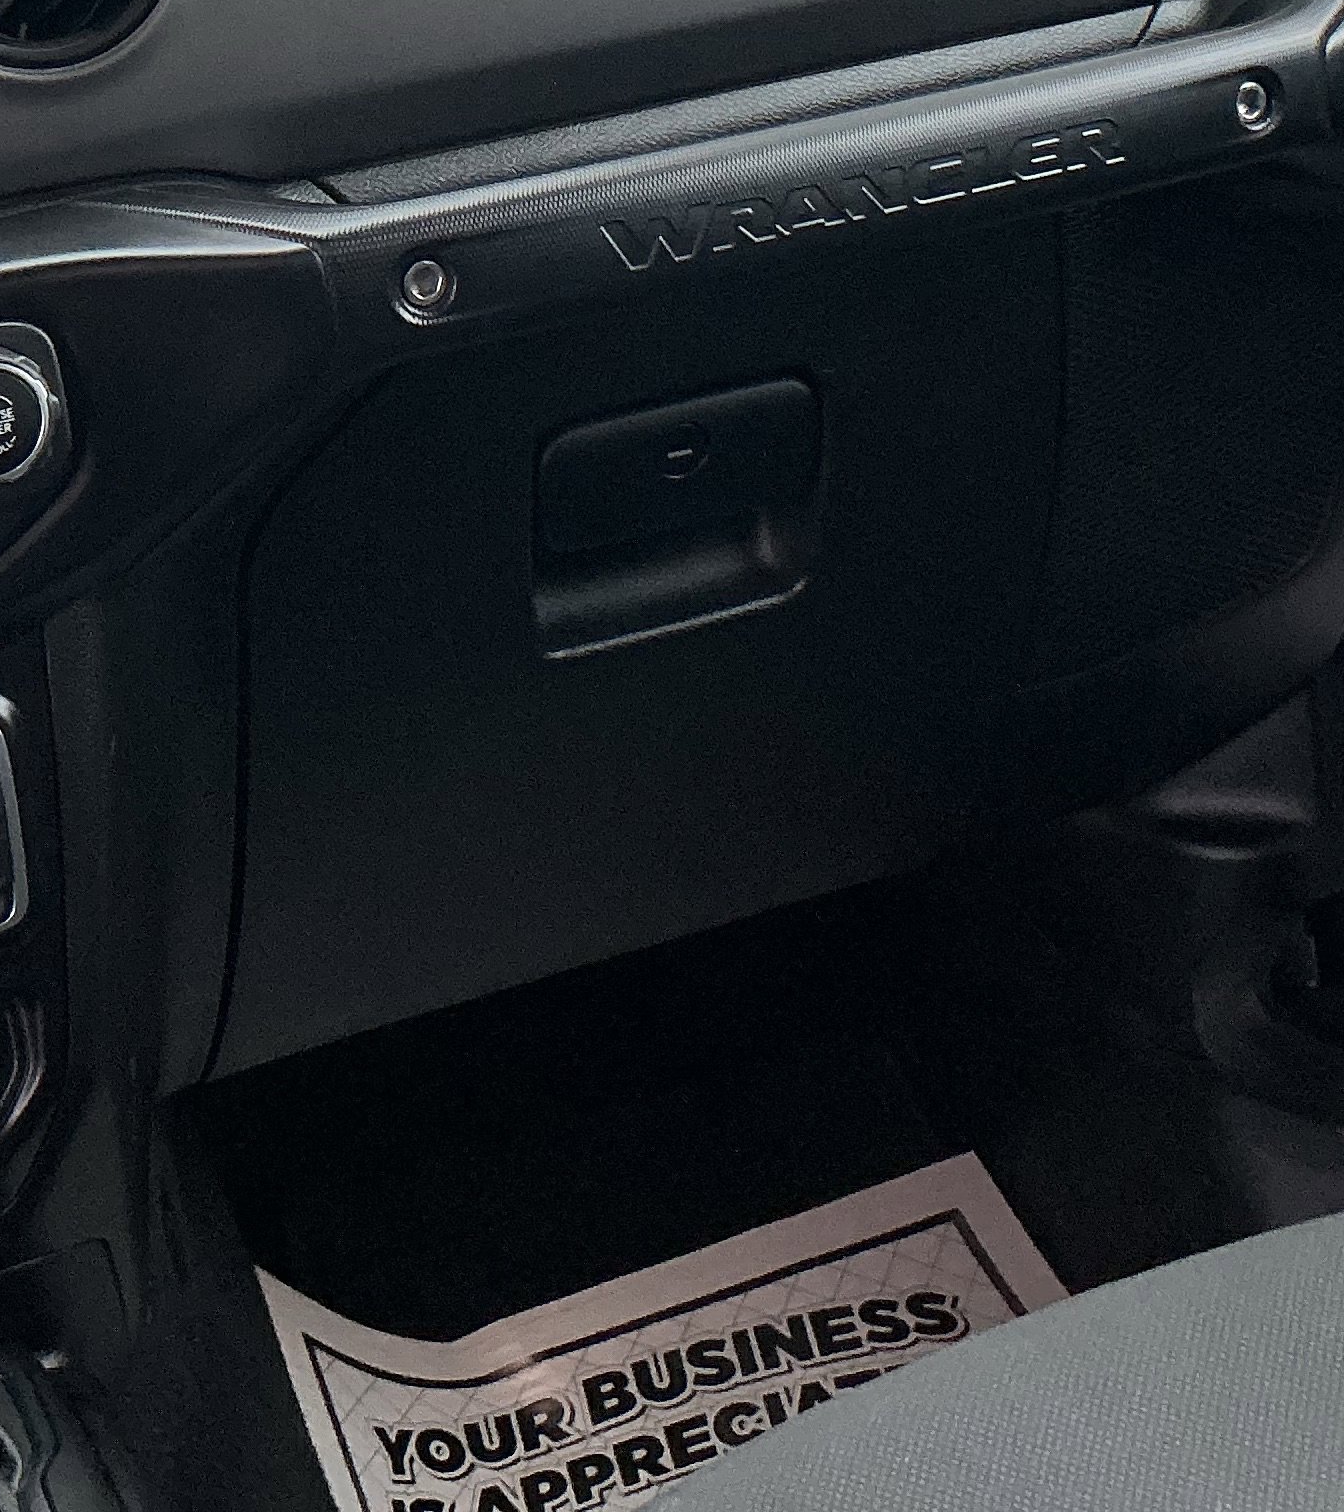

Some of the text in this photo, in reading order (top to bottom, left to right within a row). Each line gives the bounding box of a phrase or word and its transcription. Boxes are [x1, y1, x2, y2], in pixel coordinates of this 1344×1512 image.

[599, 116, 1128, 272] WRANGLER
[373, 1290, 962, 1478] YOUR BUSINESS
